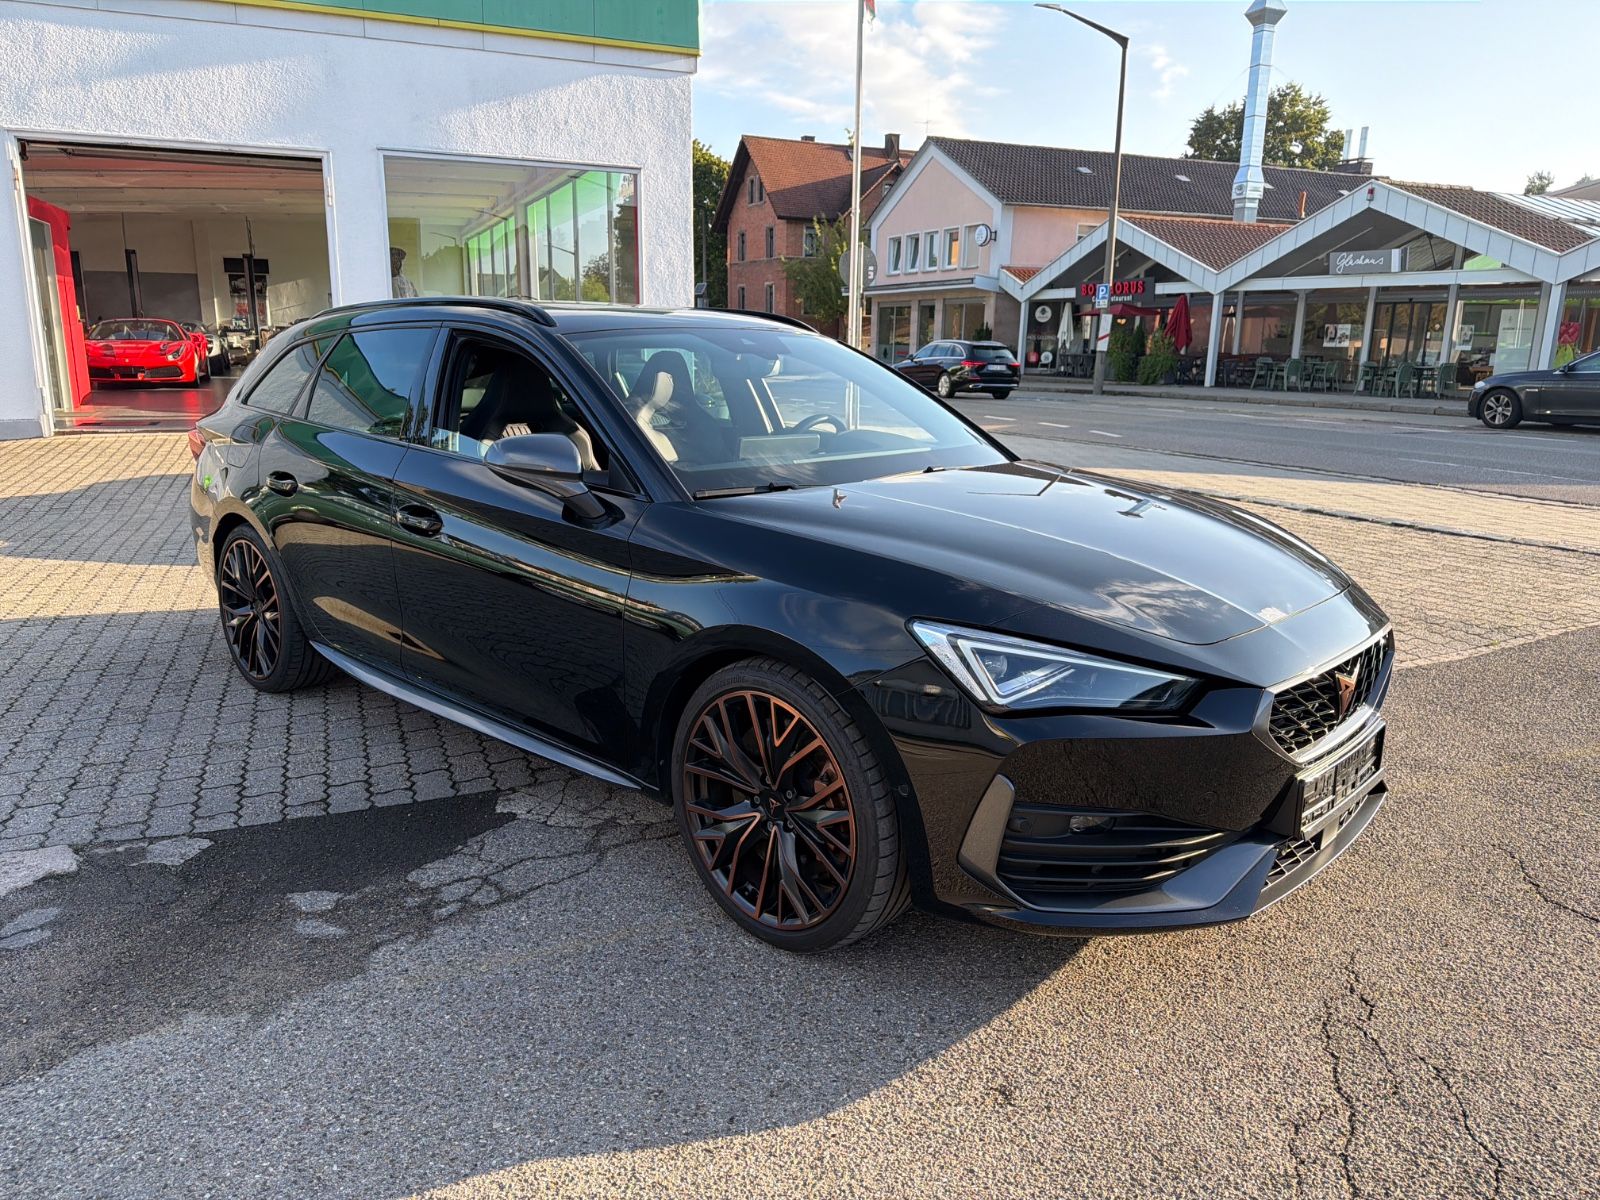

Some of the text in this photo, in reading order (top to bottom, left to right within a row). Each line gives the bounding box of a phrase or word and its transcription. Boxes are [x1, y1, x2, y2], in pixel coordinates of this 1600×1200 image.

[1336, 252, 1383, 274] Glashaus
[1081, 281, 1143, 296] BOORUS
[1110, 294, 1132, 302] staurant
